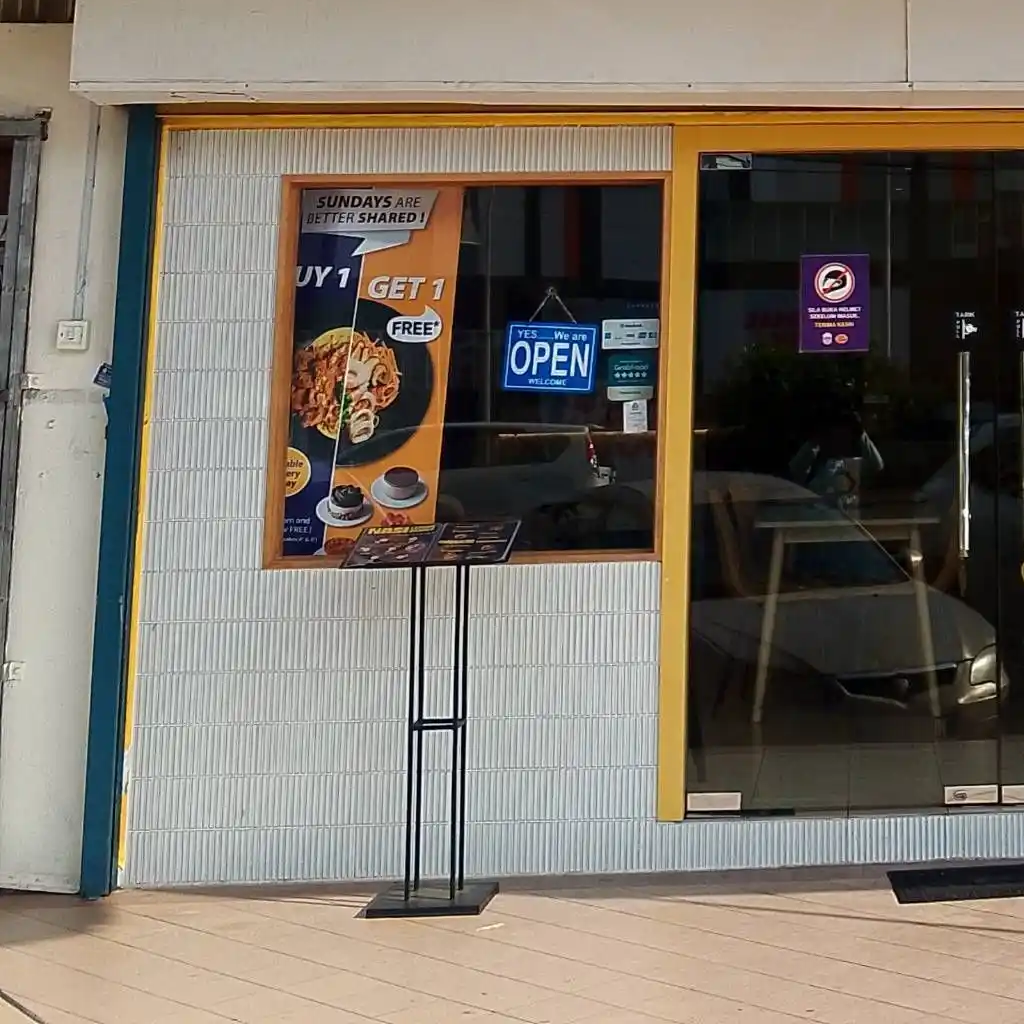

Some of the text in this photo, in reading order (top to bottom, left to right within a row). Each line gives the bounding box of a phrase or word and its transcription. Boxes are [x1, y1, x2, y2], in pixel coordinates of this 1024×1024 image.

[316, 195, 422, 208] SUNDAYS ARE
[306, 212, 355, 224] BETTER
[357, 212, 417, 224] SHARED
[337, 267, 351, 289] 1
[367, 275, 446, 301] GET 1
[554, 330, 569, 341] We
[572, 332, 588, 342] are
[510, 340, 591, 378] OPEN
[528, 378, 568, 386] WELCOME
